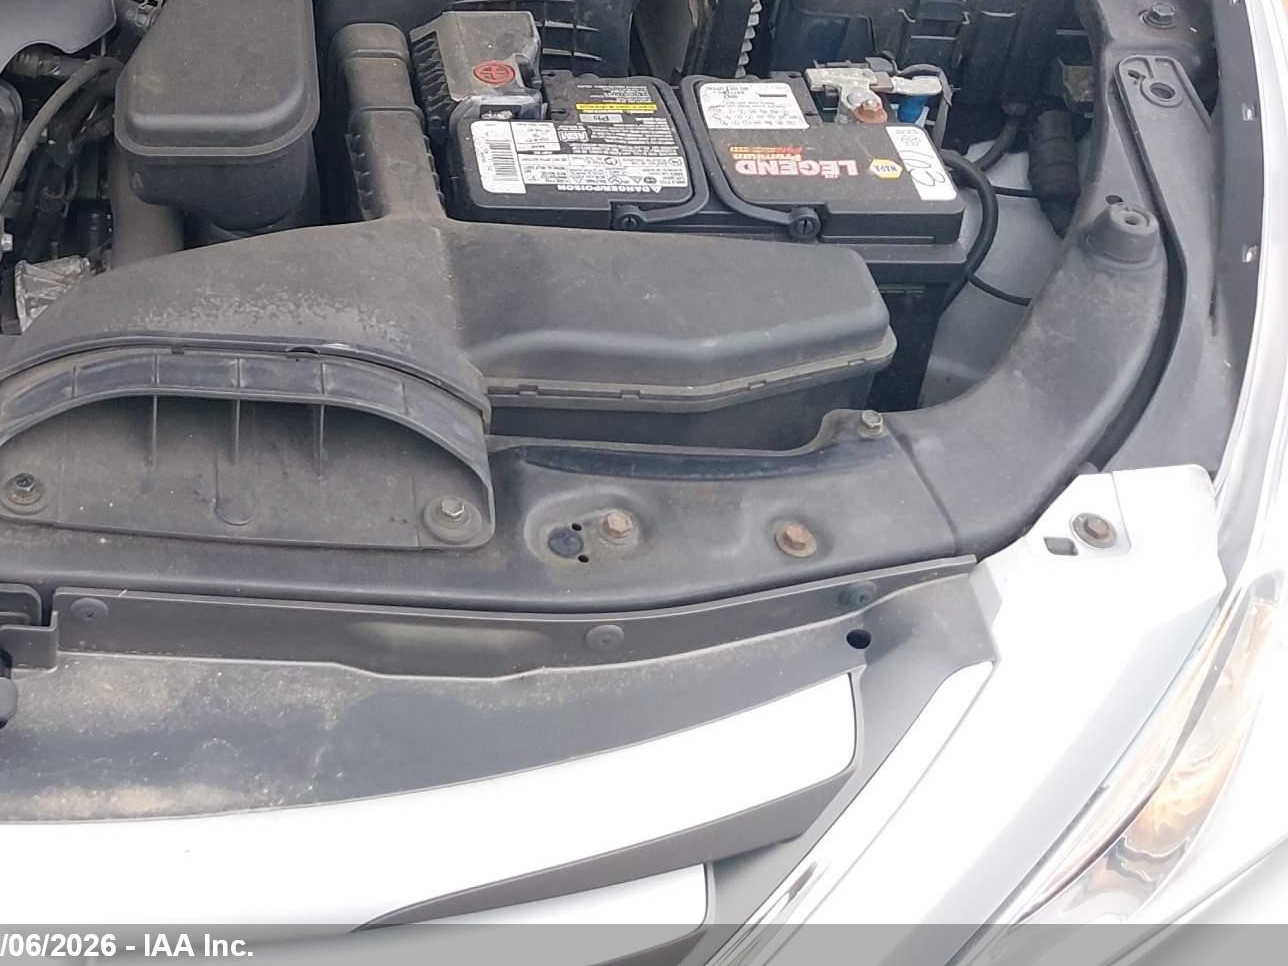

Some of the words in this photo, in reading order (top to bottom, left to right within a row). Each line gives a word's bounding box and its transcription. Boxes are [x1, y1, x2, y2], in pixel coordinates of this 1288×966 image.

[732, 153, 802, 162] Premium
[735, 159, 858, 176] LEGEND
[873, 163, 899, 174] NAPA
